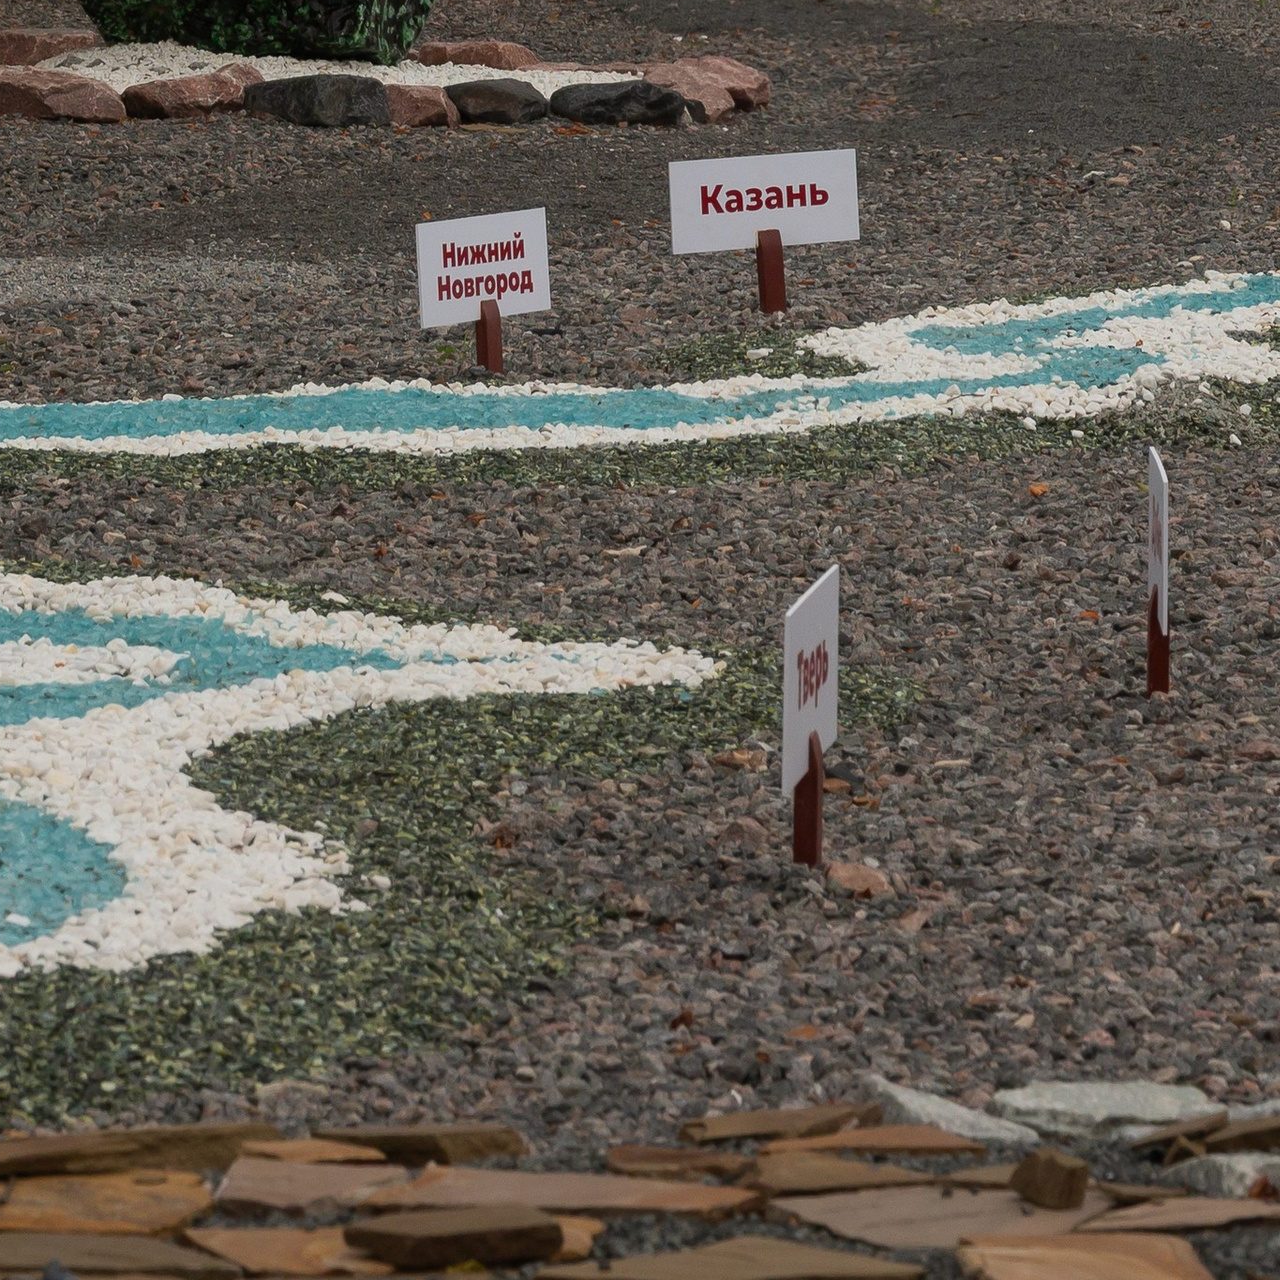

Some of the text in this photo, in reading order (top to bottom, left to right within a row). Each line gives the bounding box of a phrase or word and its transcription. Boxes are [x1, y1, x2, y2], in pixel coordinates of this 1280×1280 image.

[700, 182, 829, 216] Казань
[442, 231, 525, 269] Нижний
[437, 269, 534, 301] Новгород
[797, 639, 829, 712] Тверь
